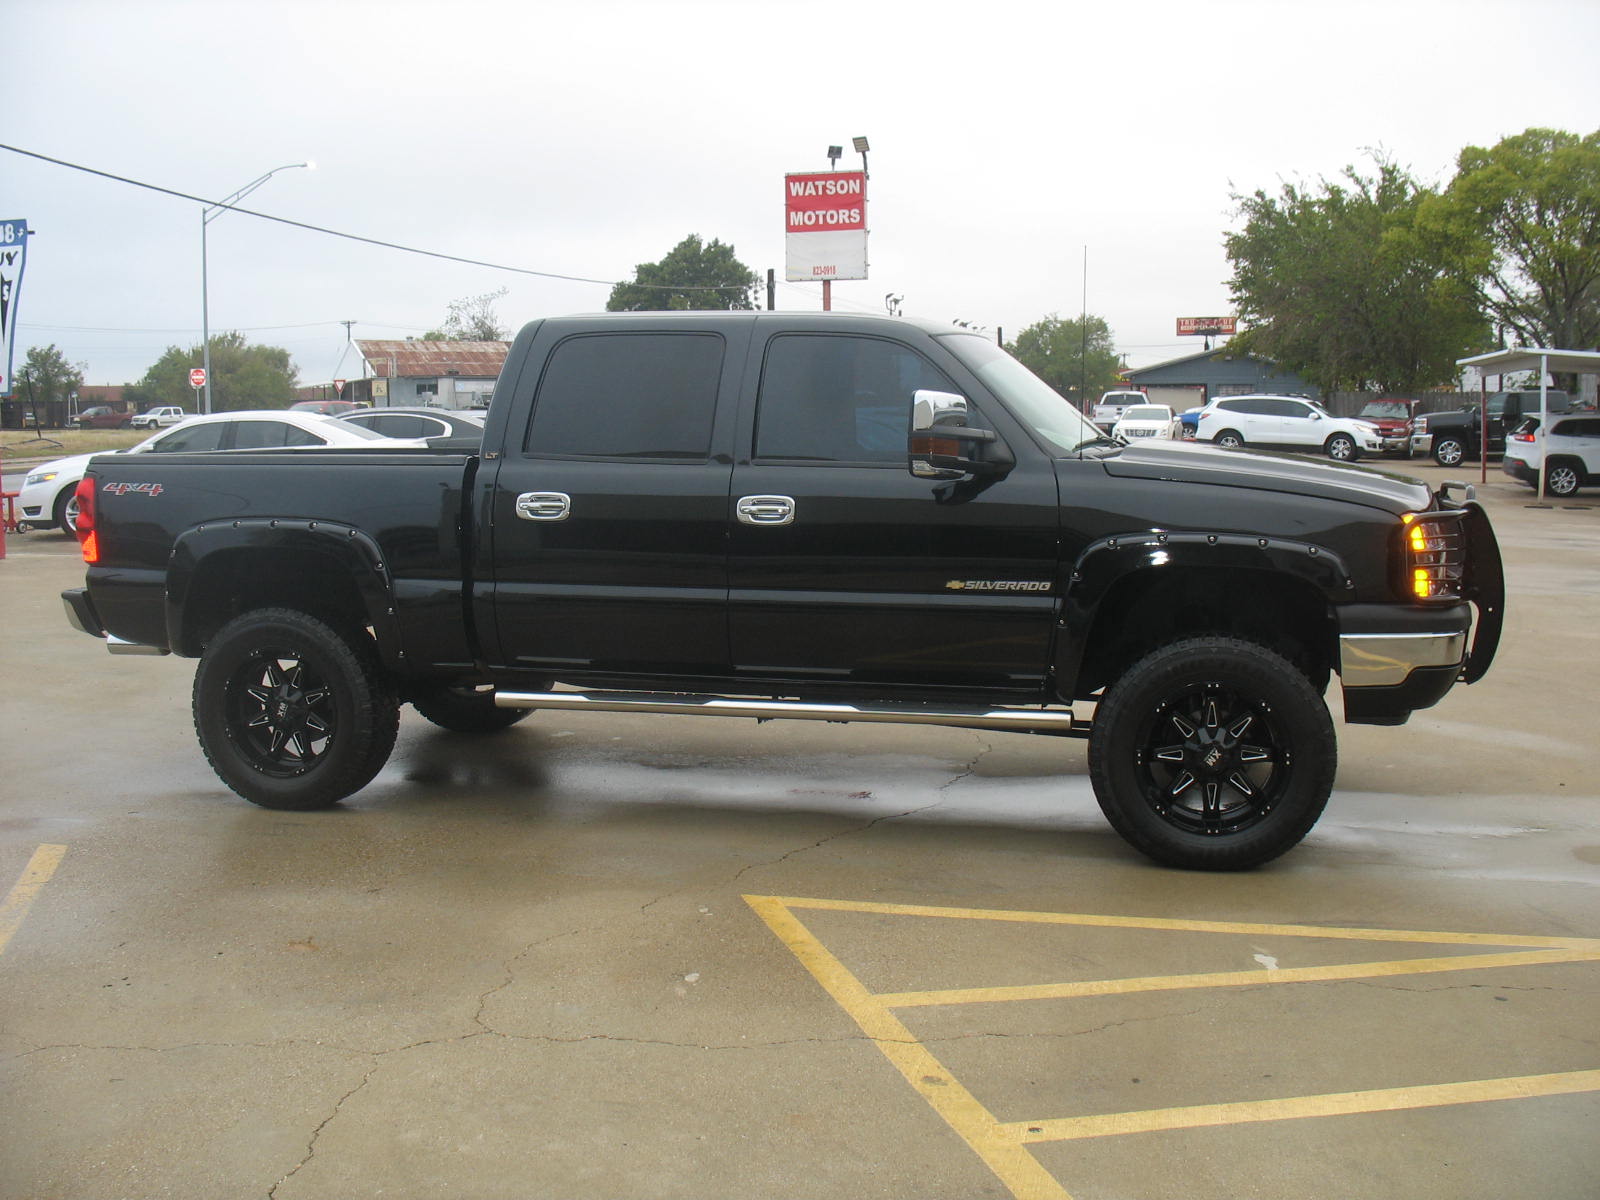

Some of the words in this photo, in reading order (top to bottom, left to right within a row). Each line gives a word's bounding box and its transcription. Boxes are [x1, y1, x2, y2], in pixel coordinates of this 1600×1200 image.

[789, 179, 861, 197] WATSON
[790, 208, 861, 226] MOTORS
[964, 580, 1052, 591] SILVERADO
